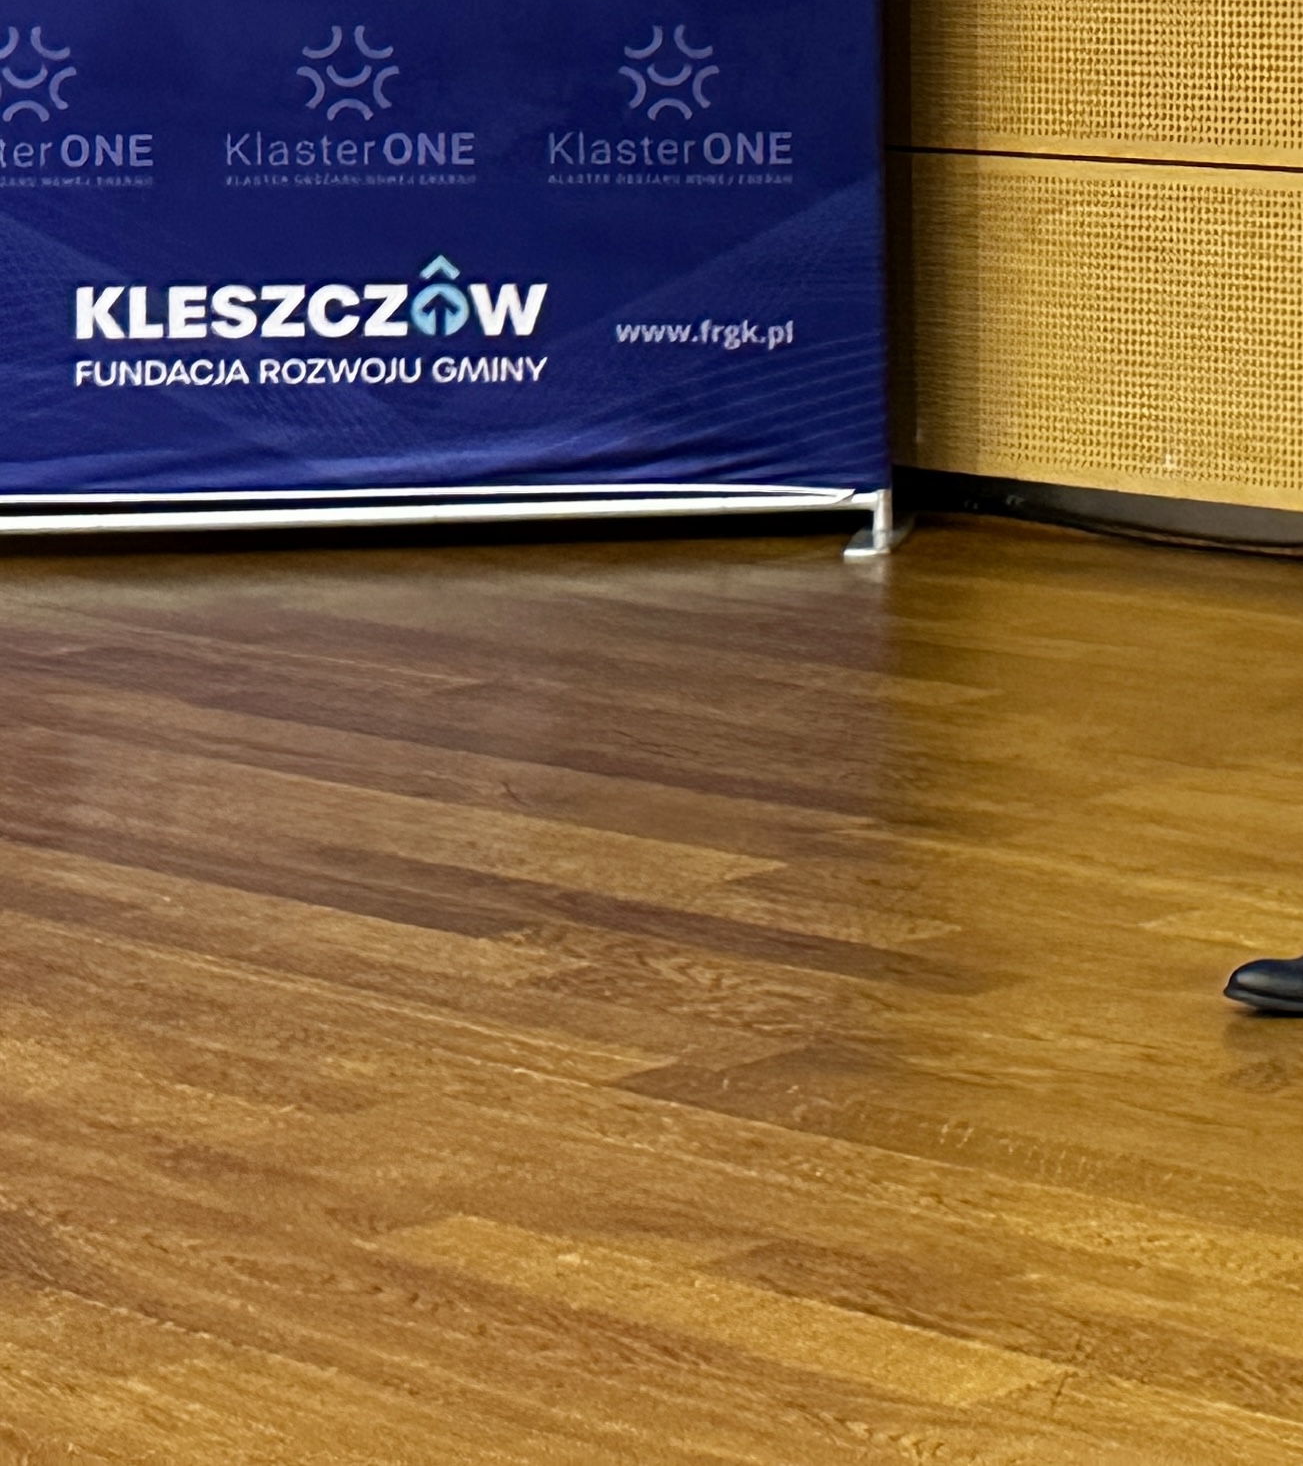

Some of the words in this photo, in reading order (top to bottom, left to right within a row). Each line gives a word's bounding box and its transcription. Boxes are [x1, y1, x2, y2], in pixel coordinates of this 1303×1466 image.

[615, 319, 794, 351] www.frgk.pl
[75, 358, 250, 387] FUNDACJA
[259, 357, 422, 385] ROZWOJU
[431, 356, 548, 384] GMINY
